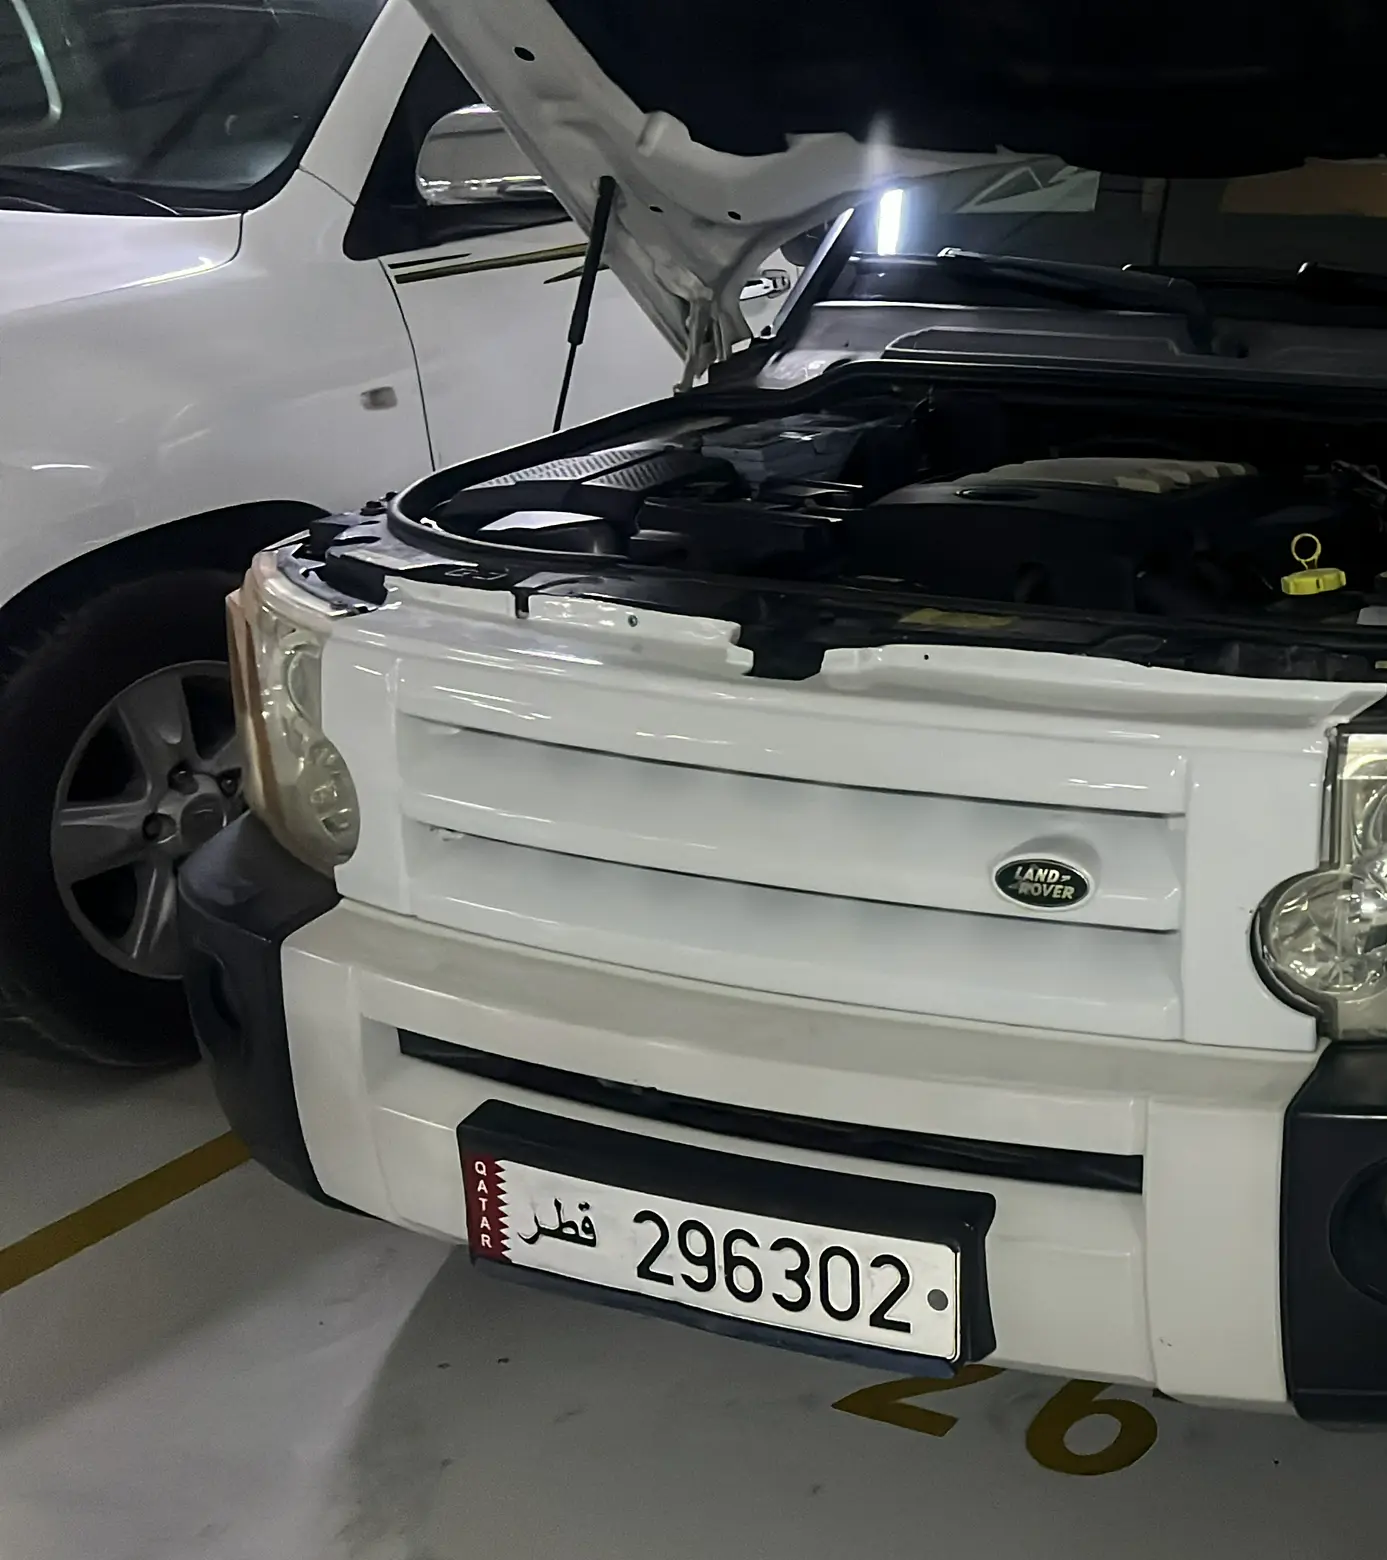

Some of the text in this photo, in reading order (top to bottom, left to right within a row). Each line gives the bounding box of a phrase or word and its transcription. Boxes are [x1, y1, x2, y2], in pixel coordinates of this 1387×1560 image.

[1014, 866, 1060, 883] LAND
[1018, 881, 1075, 899] ROVER
[474, 1160, 493, 1249] QATAR
[516, 1197, 597, 1248] قطر
[631, 1209, 912, 1334] 296302
